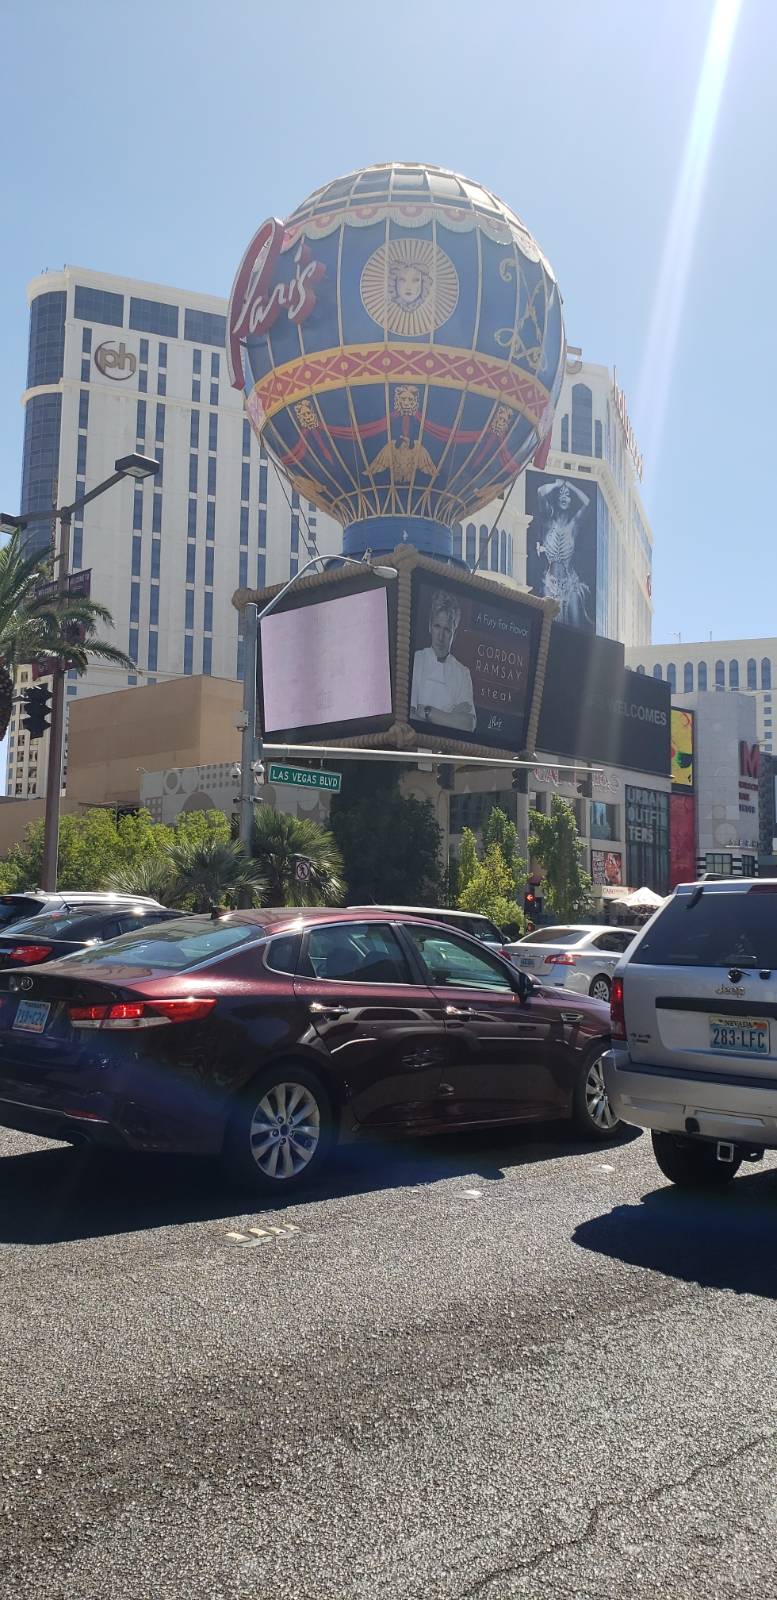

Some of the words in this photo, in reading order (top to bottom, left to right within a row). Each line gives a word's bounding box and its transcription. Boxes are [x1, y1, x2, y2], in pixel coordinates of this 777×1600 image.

[226, 217, 324, 391] Paris
[99, 342, 137, 373] ph
[477, 643, 523, 668] GORDON
[475, 659, 523, 681] RAMSAY
[738, 740, 760, 779] M
[272, 769, 289, 781] LAS
[292, 772, 317, 785] VEGAS
[319, 776, 338, 787] BLVD
[627, 786, 667, 808] URBAN
[628, 825, 655, 843] TERS
[715, 984, 745, 999] Jeep
